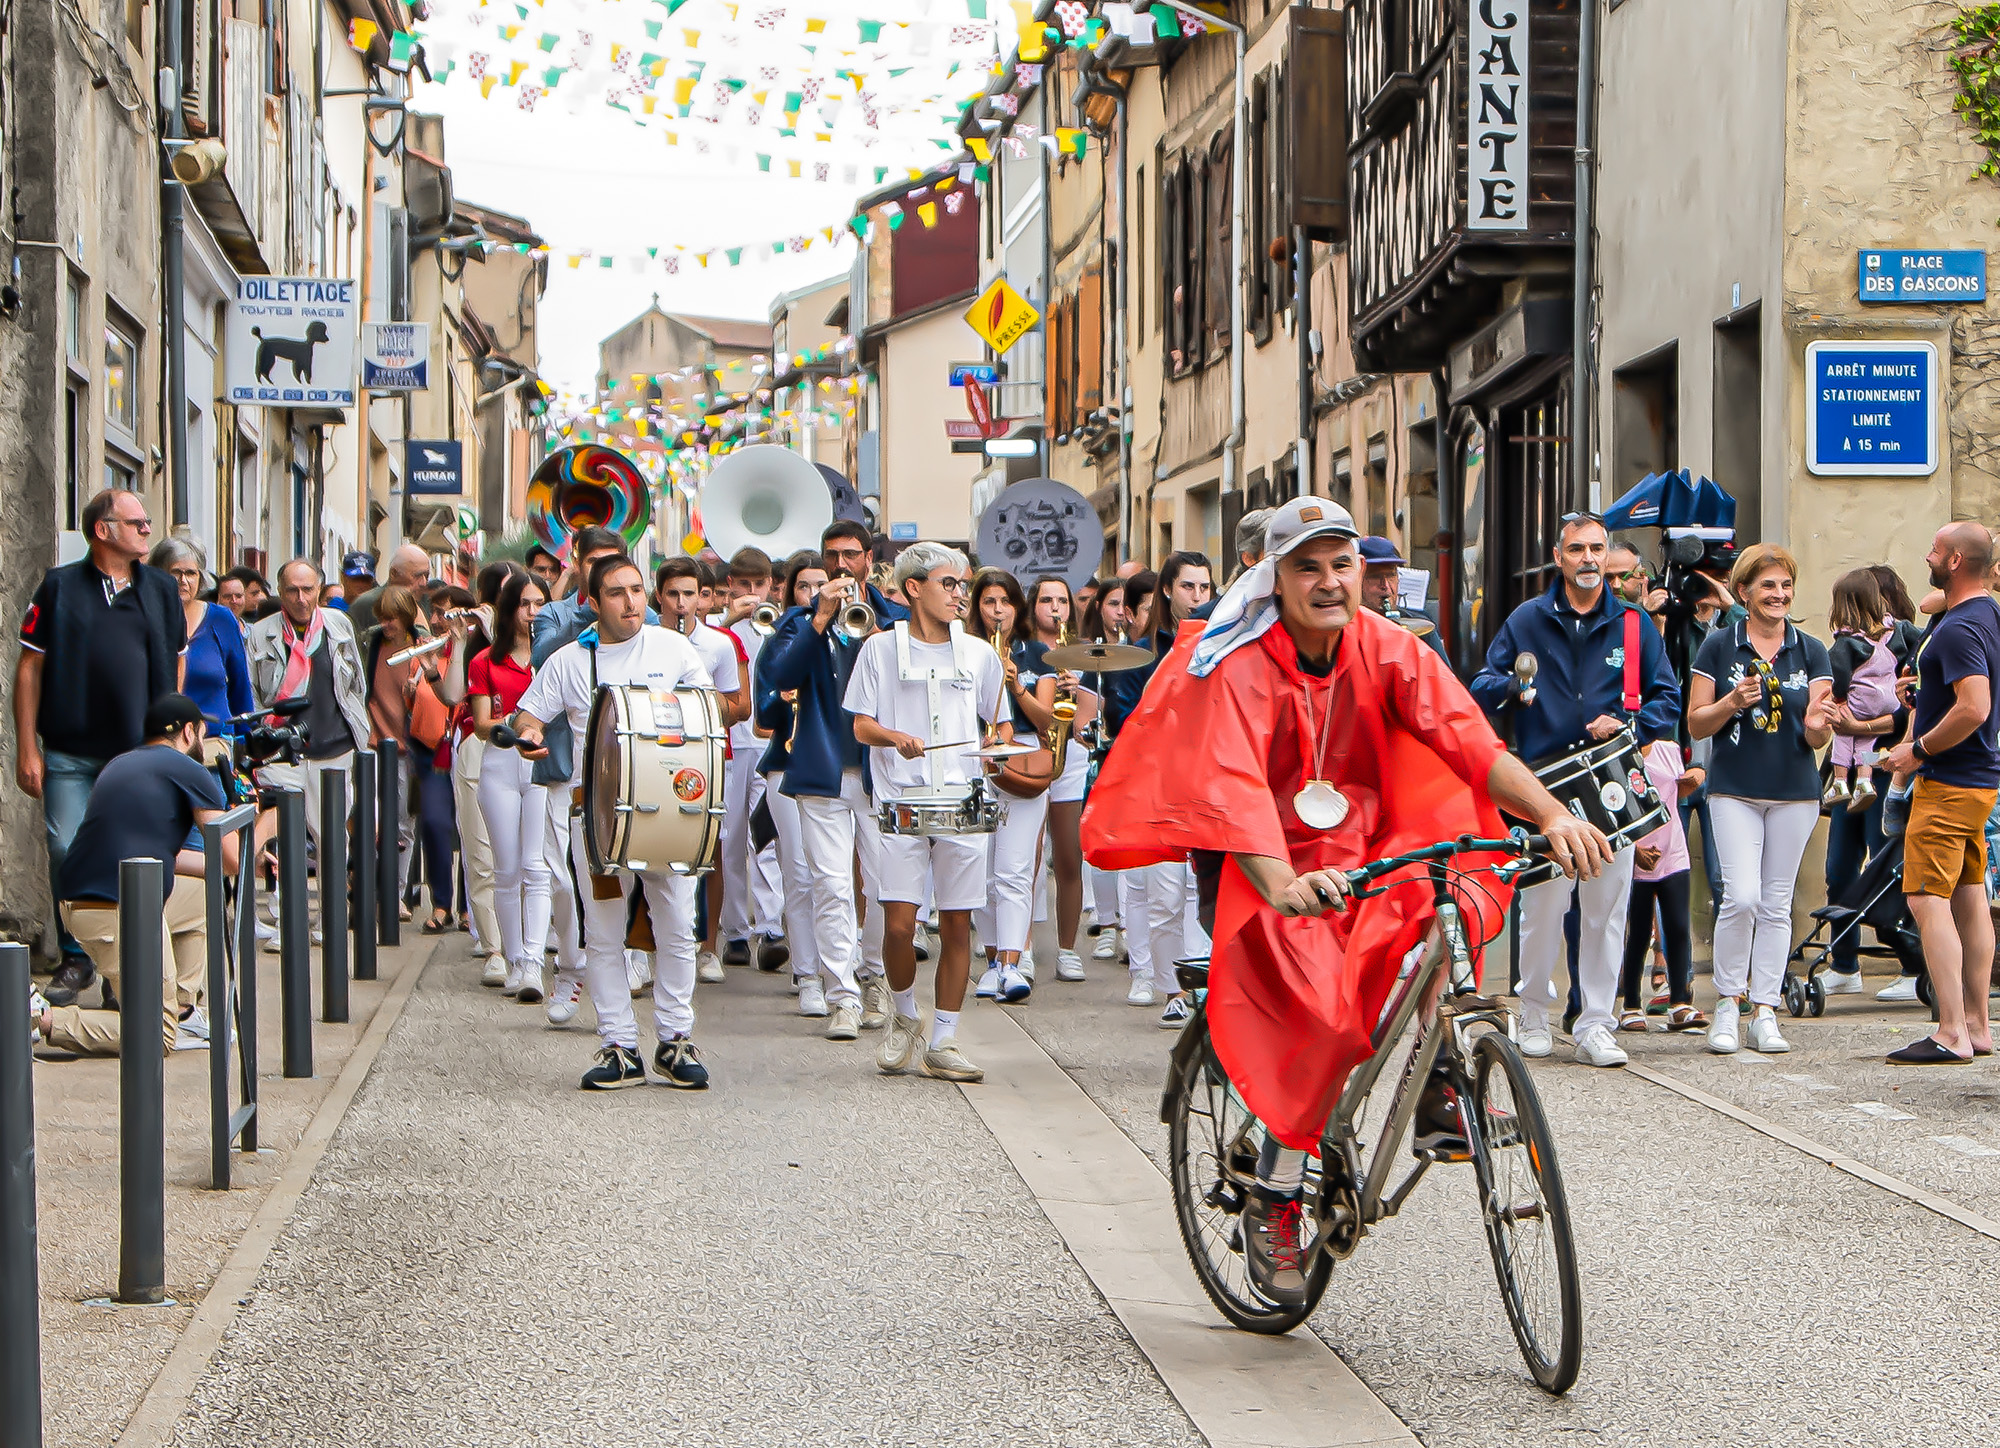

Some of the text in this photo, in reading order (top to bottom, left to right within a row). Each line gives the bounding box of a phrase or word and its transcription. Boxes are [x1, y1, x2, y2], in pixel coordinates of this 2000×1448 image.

[1902, 256, 1943, 269] PLACE
[1866, 276, 1979, 292] DES GASCONS
[996, 310, 1031, 347] PRESSE
[1827, 362, 1917, 377] ARRÊT MINUTE
[1823, 389, 1921, 402] STATIONNEMENT
[1853, 413, 1891, 426] LIMITÉ
[1843, 437, 1900, 451] À 15 min
[413, 470, 456, 482] HUMAN
